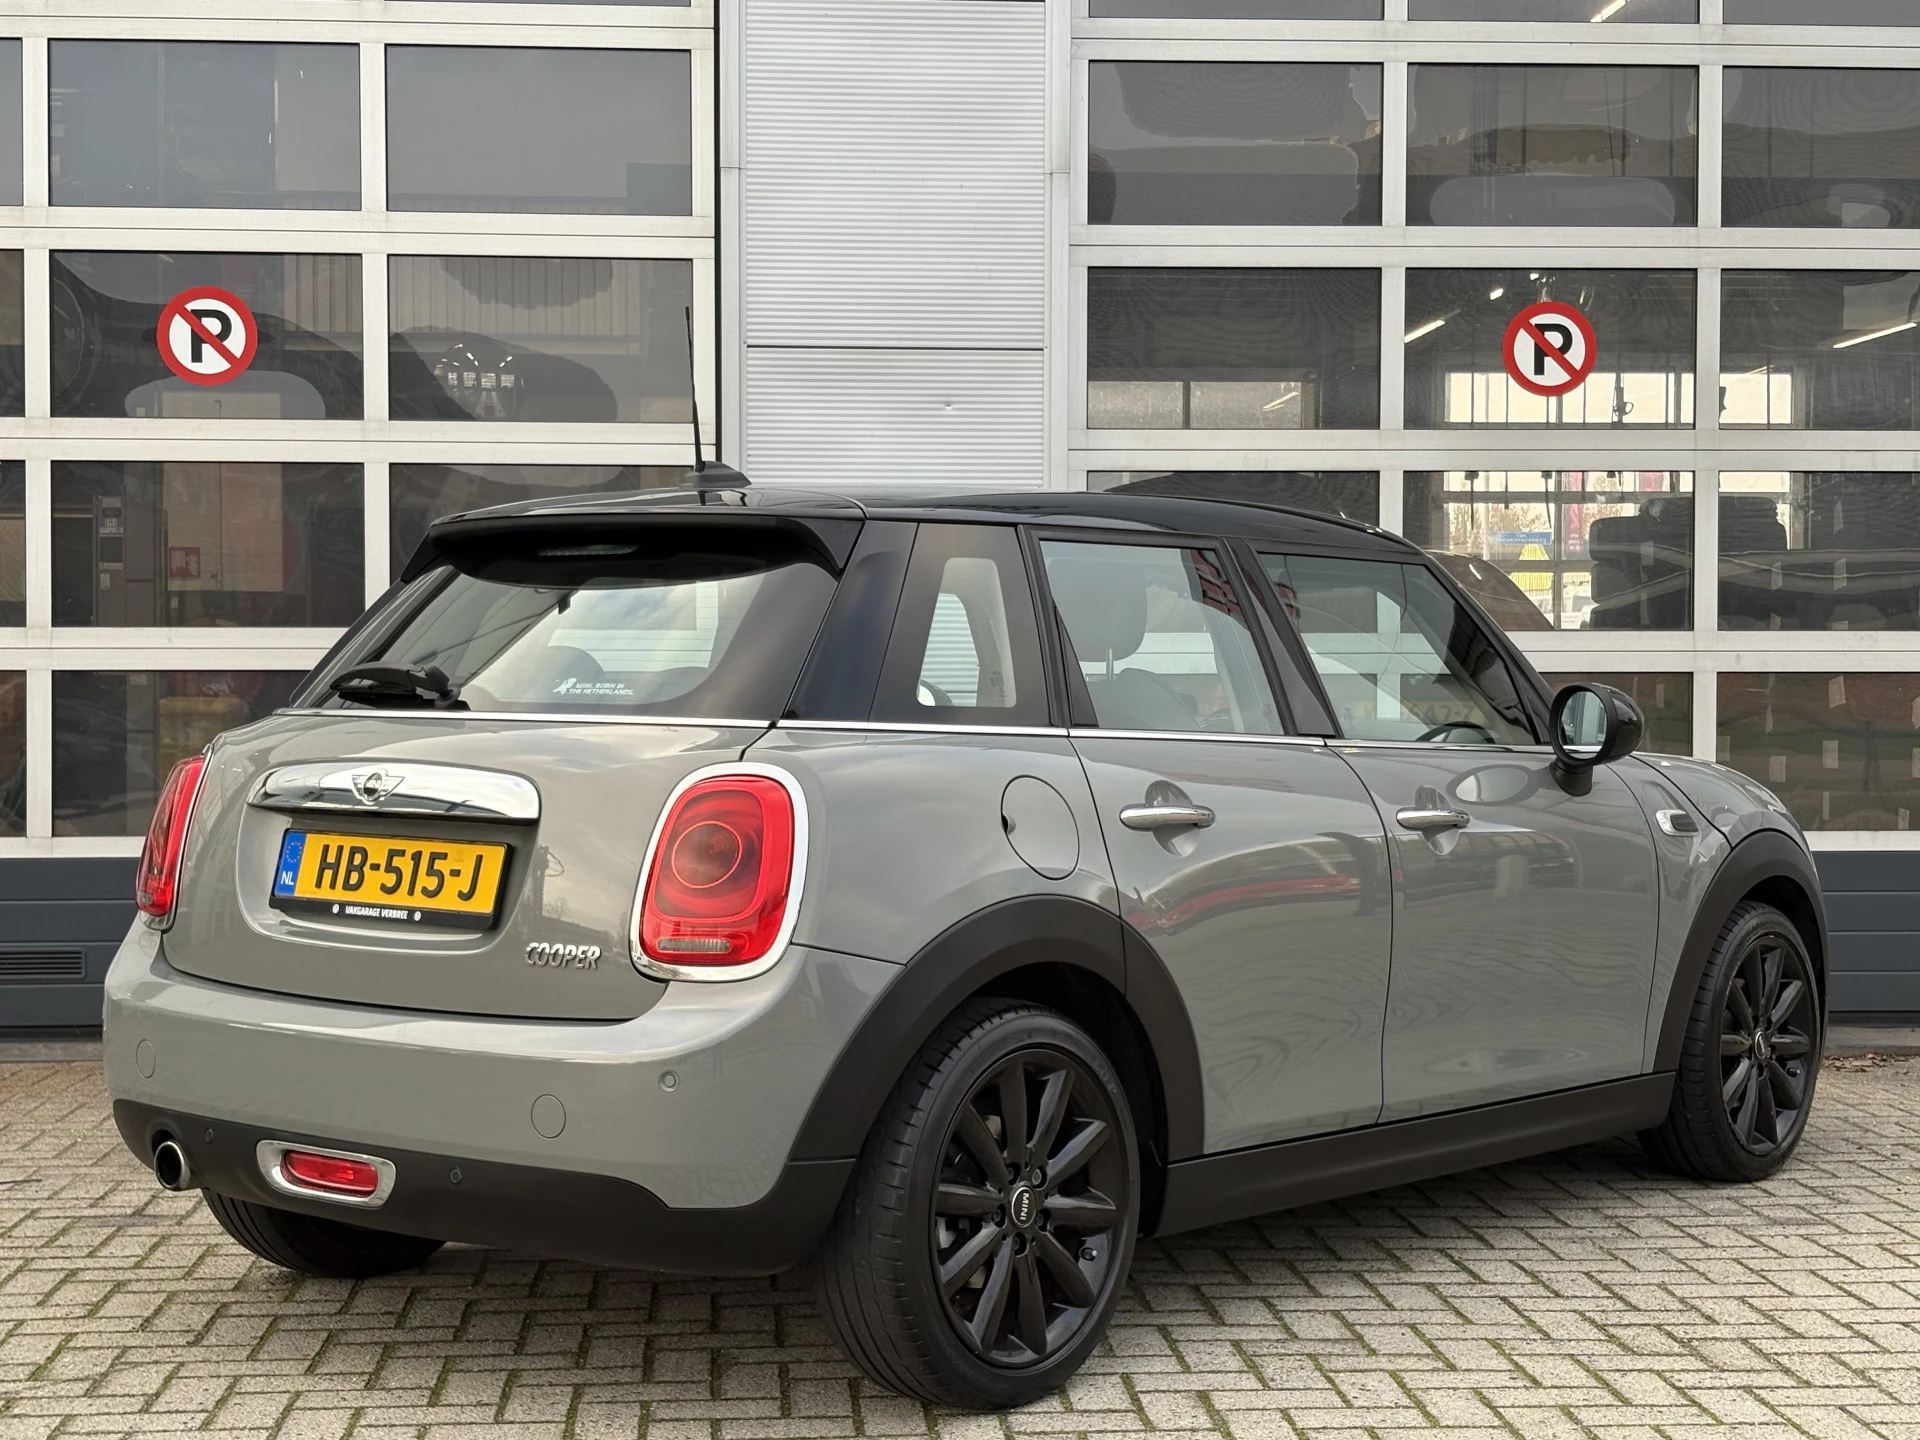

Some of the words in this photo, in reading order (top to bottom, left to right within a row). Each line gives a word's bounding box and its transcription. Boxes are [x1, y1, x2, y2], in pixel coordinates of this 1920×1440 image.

[190, 309, 232, 363] P
[1534, 323, 1573, 376] P
[281, 870, 295, 885] NL
[314, 844, 483, 902] HB-515-J
[345, 905, 380, 917] VAKGARAGE
[381, 908, 408, 920] VERBREE
[525, 942, 602, 969] COOPER
[1020, 1193, 1030, 1220] MINI
